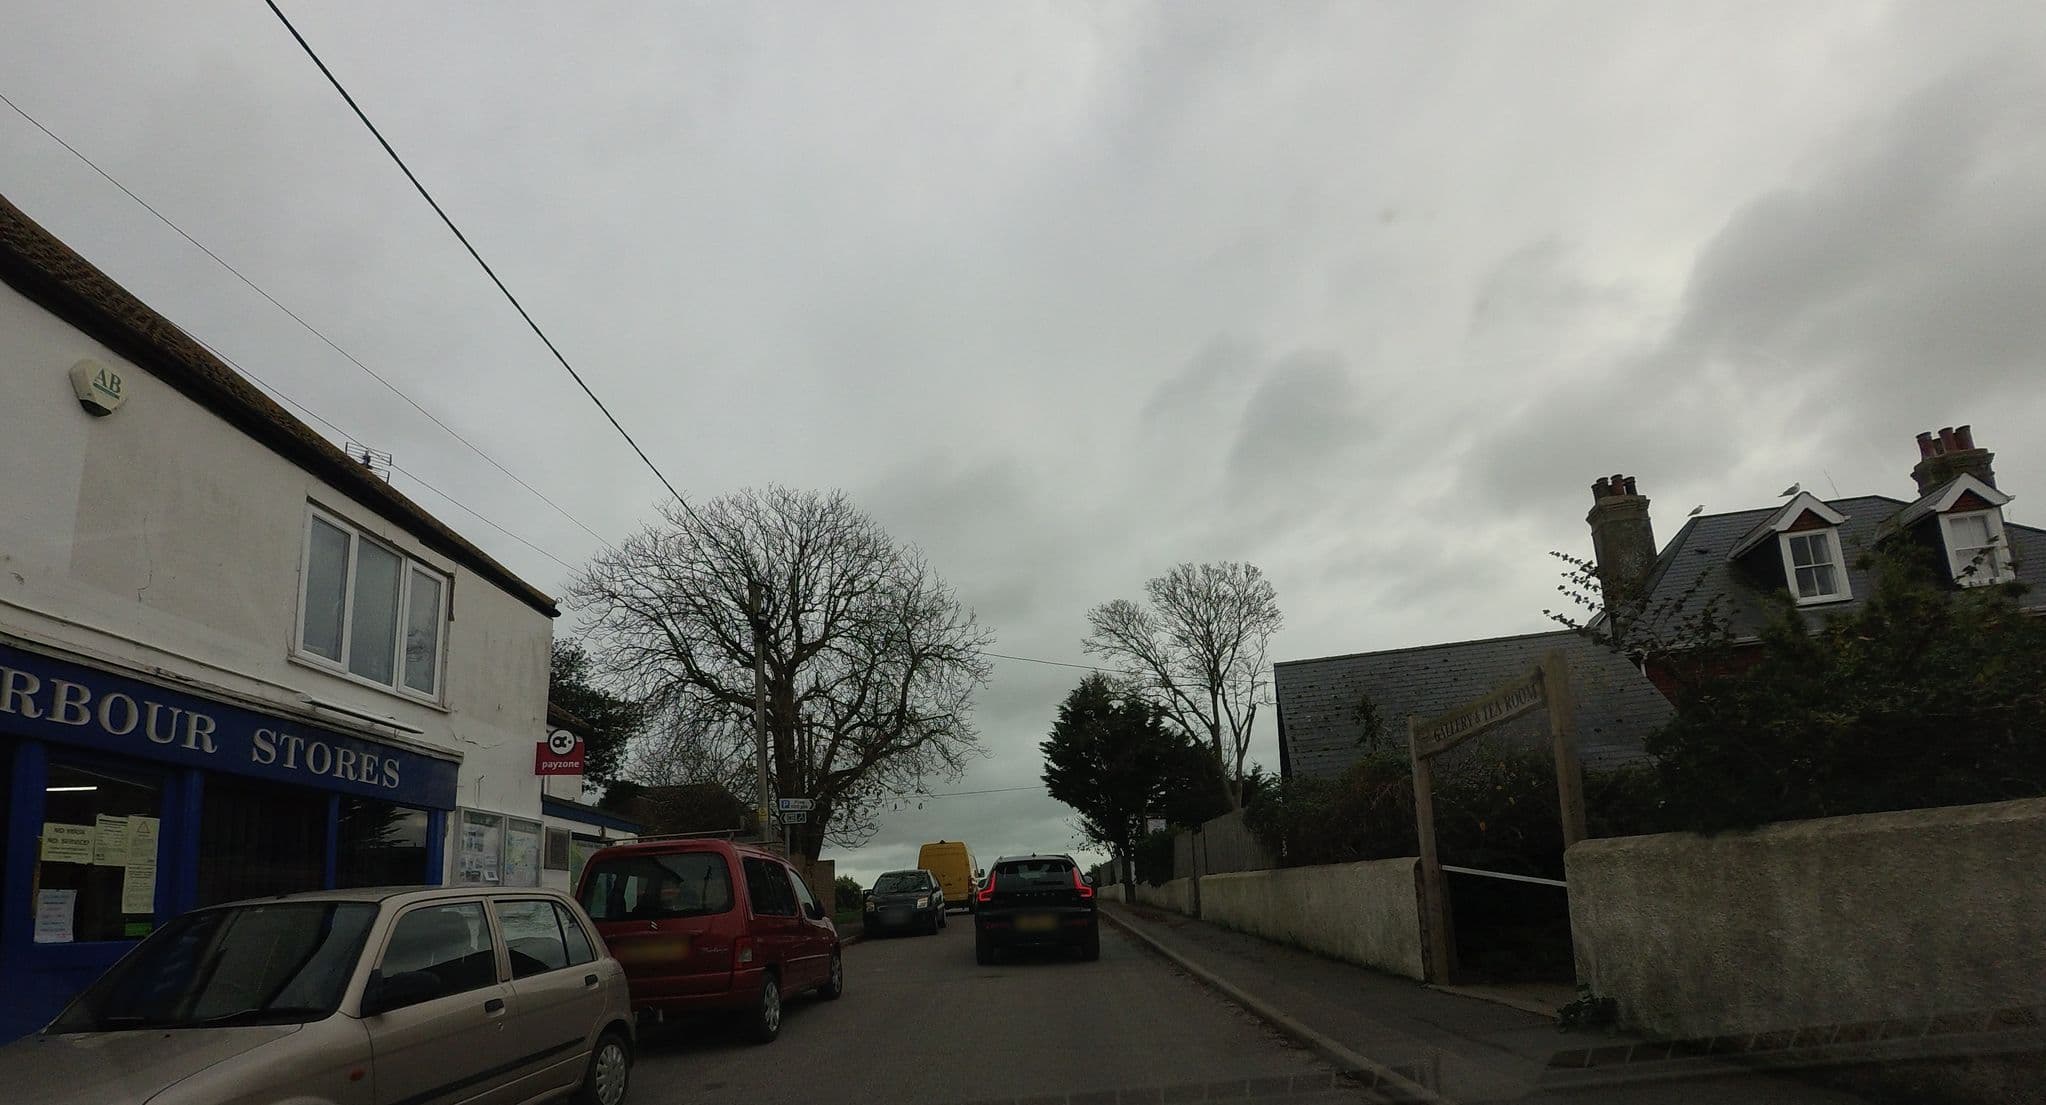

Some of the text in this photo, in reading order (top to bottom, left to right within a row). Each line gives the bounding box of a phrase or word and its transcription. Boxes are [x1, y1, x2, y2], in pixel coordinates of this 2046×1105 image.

[94, 367, 121, 393] AB
[1483, 700, 1503, 721] TEA
[0, 666, 400, 789] RBOUR STORES
[542, 761, 580, 771] payzone
